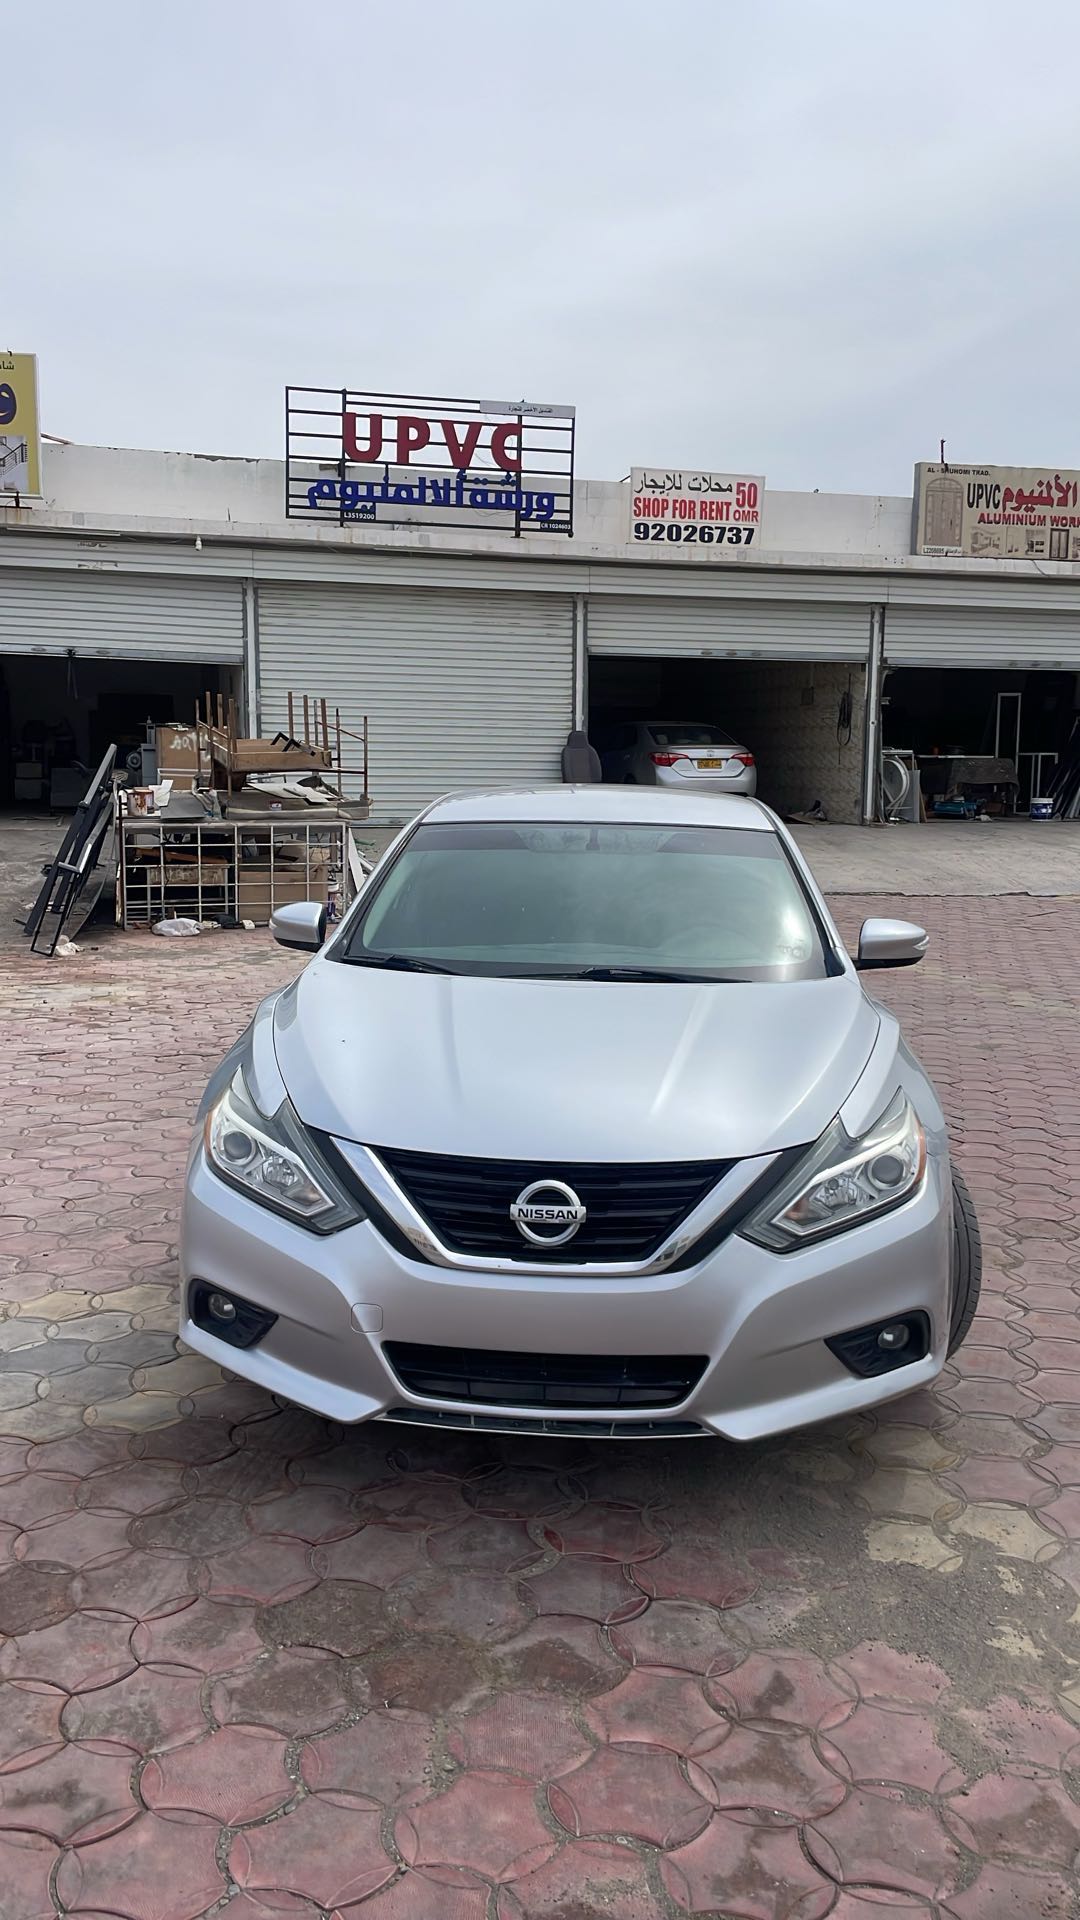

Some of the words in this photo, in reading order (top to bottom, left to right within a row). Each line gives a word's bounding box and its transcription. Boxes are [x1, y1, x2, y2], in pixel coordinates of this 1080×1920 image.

[343, 412, 522, 471] UPVC
[688, 475, 733, 493] محلات
[735, 482, 758, 509] 50
[469, 472, 555, 521] ورشة
[967, 483, 1001, 510] UPVC
[633, 497, 669, 518] SHOP
[672, 499, 696, 520] FOR
[700, 500, 732, 521] RENT
[733, 509, 759, 522] OMR
[977, 512, 1047, 527] ALUMINIUM
[634, 522, 755, 545] 92026737
[517, 1208, 578, 1220] NISSAN
